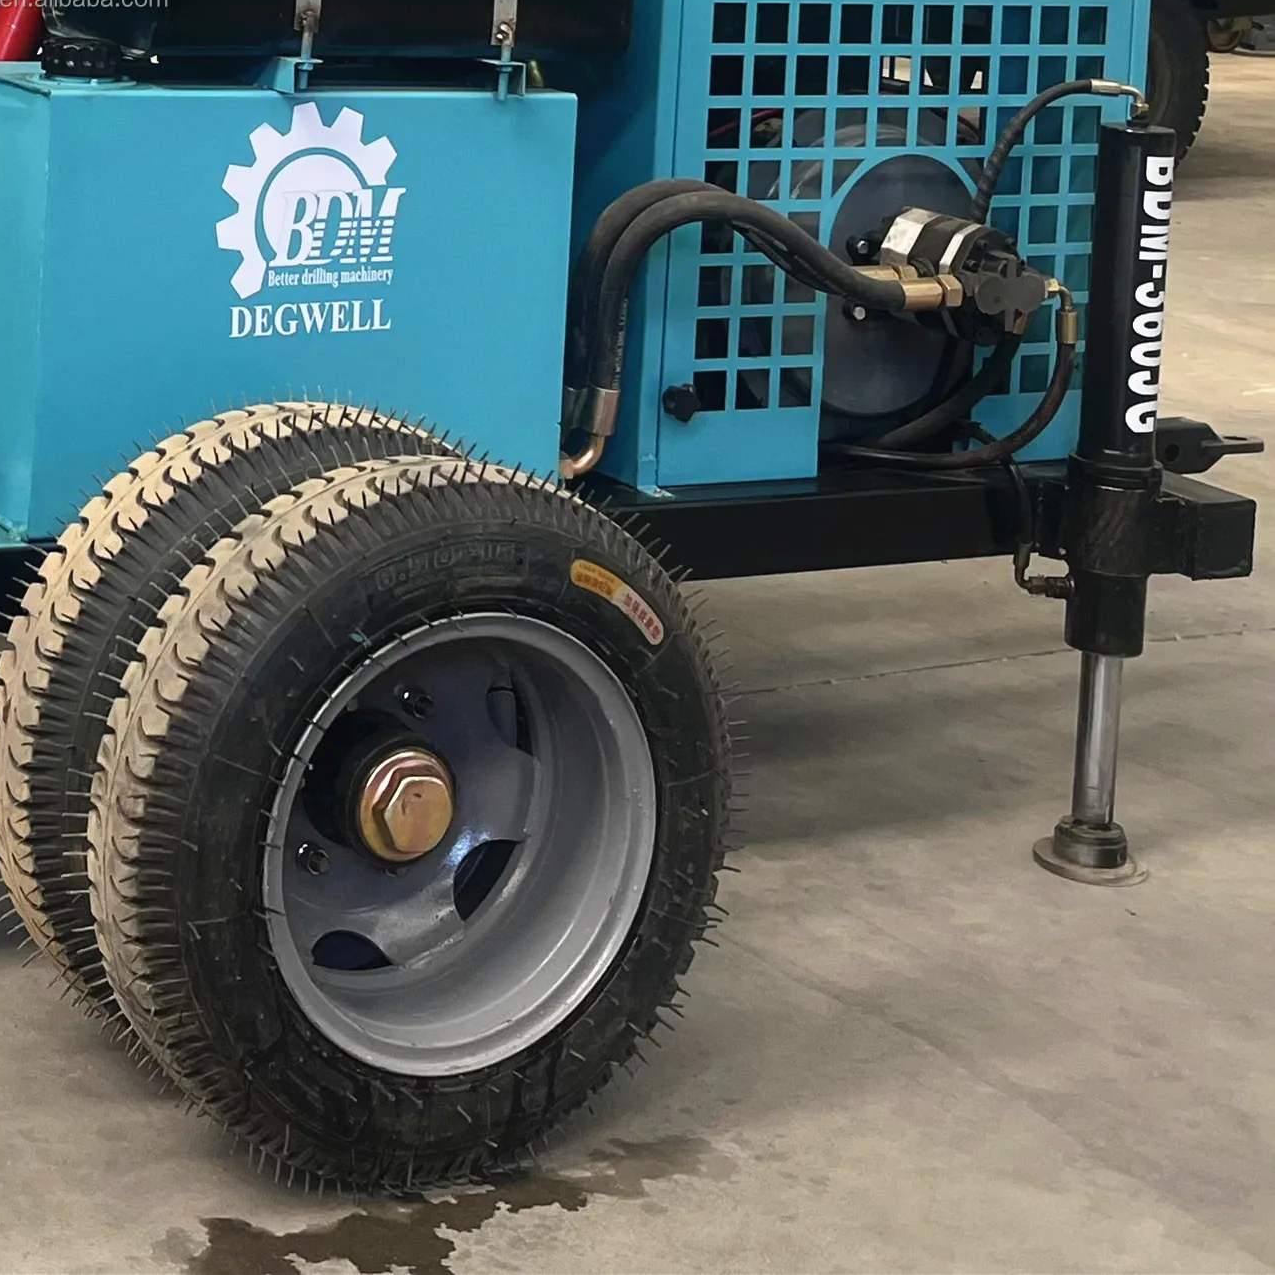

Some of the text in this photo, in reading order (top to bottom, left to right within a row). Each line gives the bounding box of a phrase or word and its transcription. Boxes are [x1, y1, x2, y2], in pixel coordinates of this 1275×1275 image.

[268, 187, 407, 267] BDM
[267, 266, 394, 288] Better drilling machinery
[229, 298, 392, 338] DEGWELL
